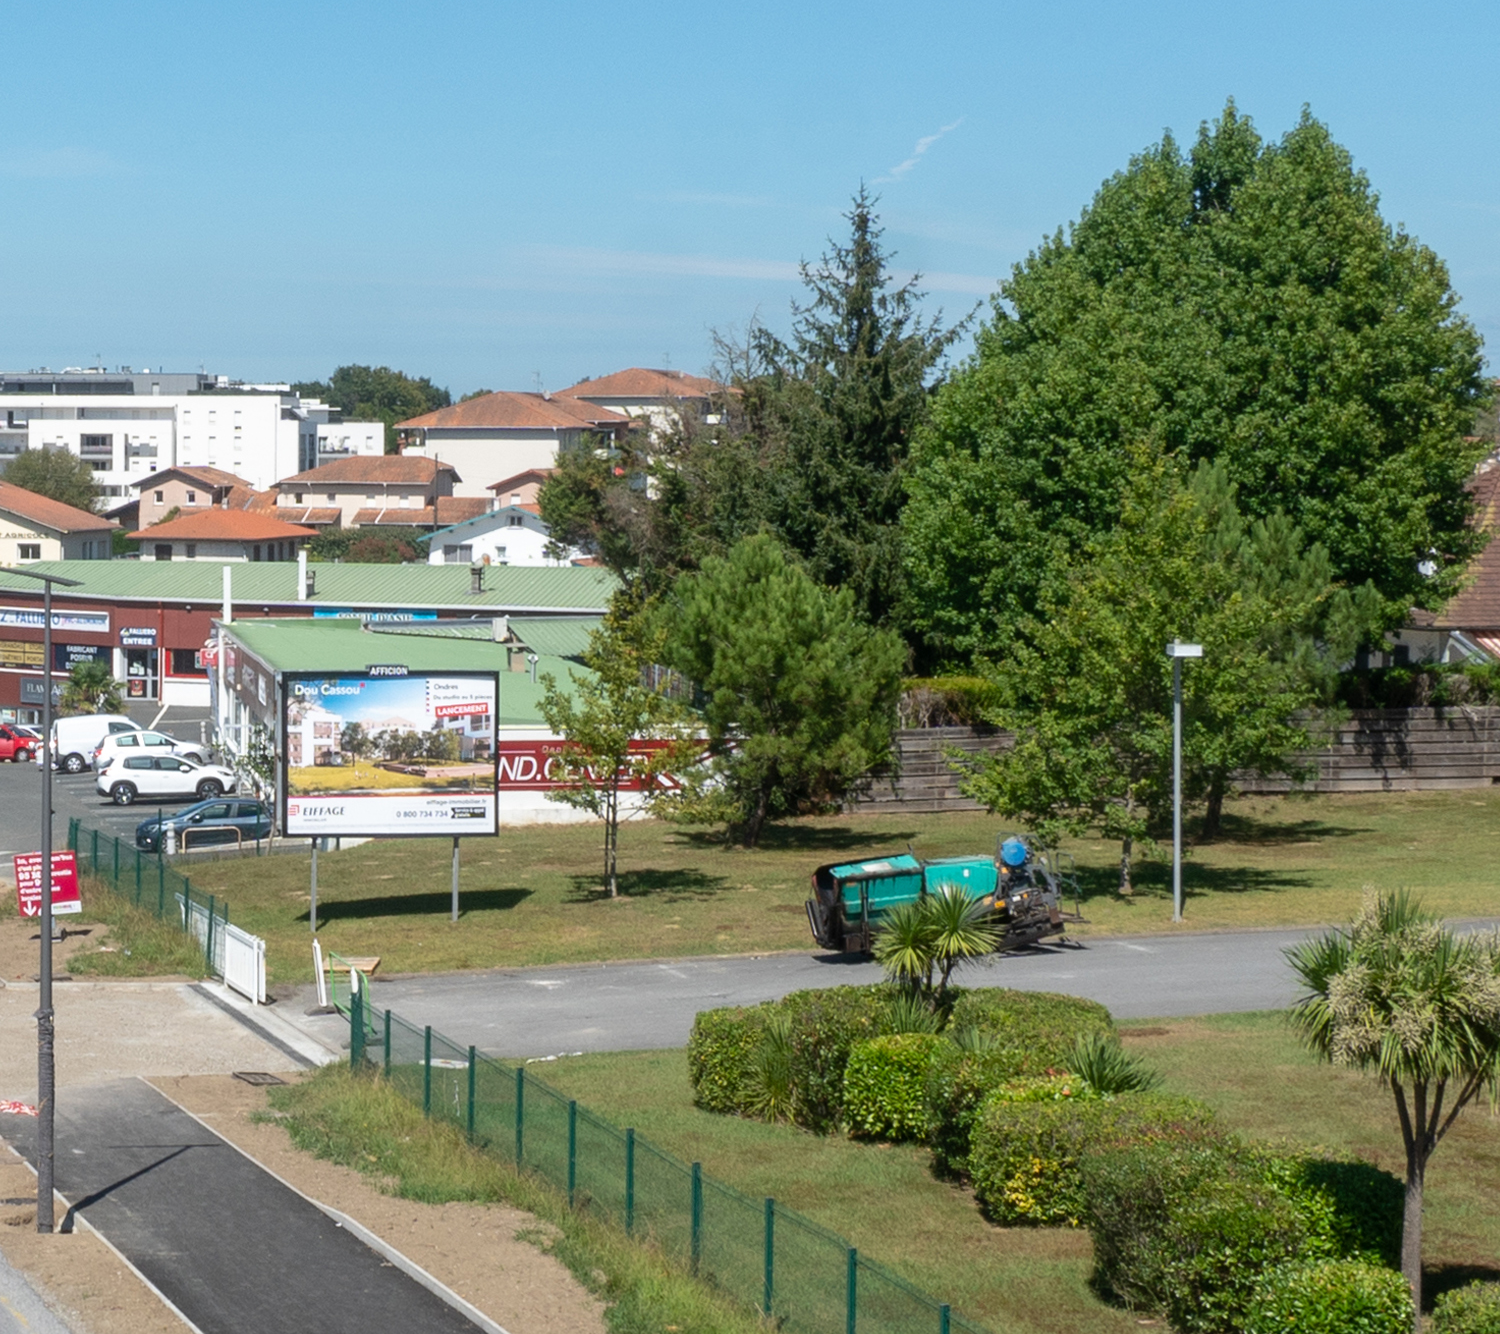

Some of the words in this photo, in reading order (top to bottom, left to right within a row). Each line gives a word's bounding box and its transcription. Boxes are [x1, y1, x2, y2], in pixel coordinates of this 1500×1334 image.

[15, 611, 60, 625] FALLIEO
[294, 684, 318, 695] Dou
[320, 684, 360, 695] Cassou
[436, 703, 487, 716] LANCEMENT
[302, 805, 345, 816] EIFFAGE
